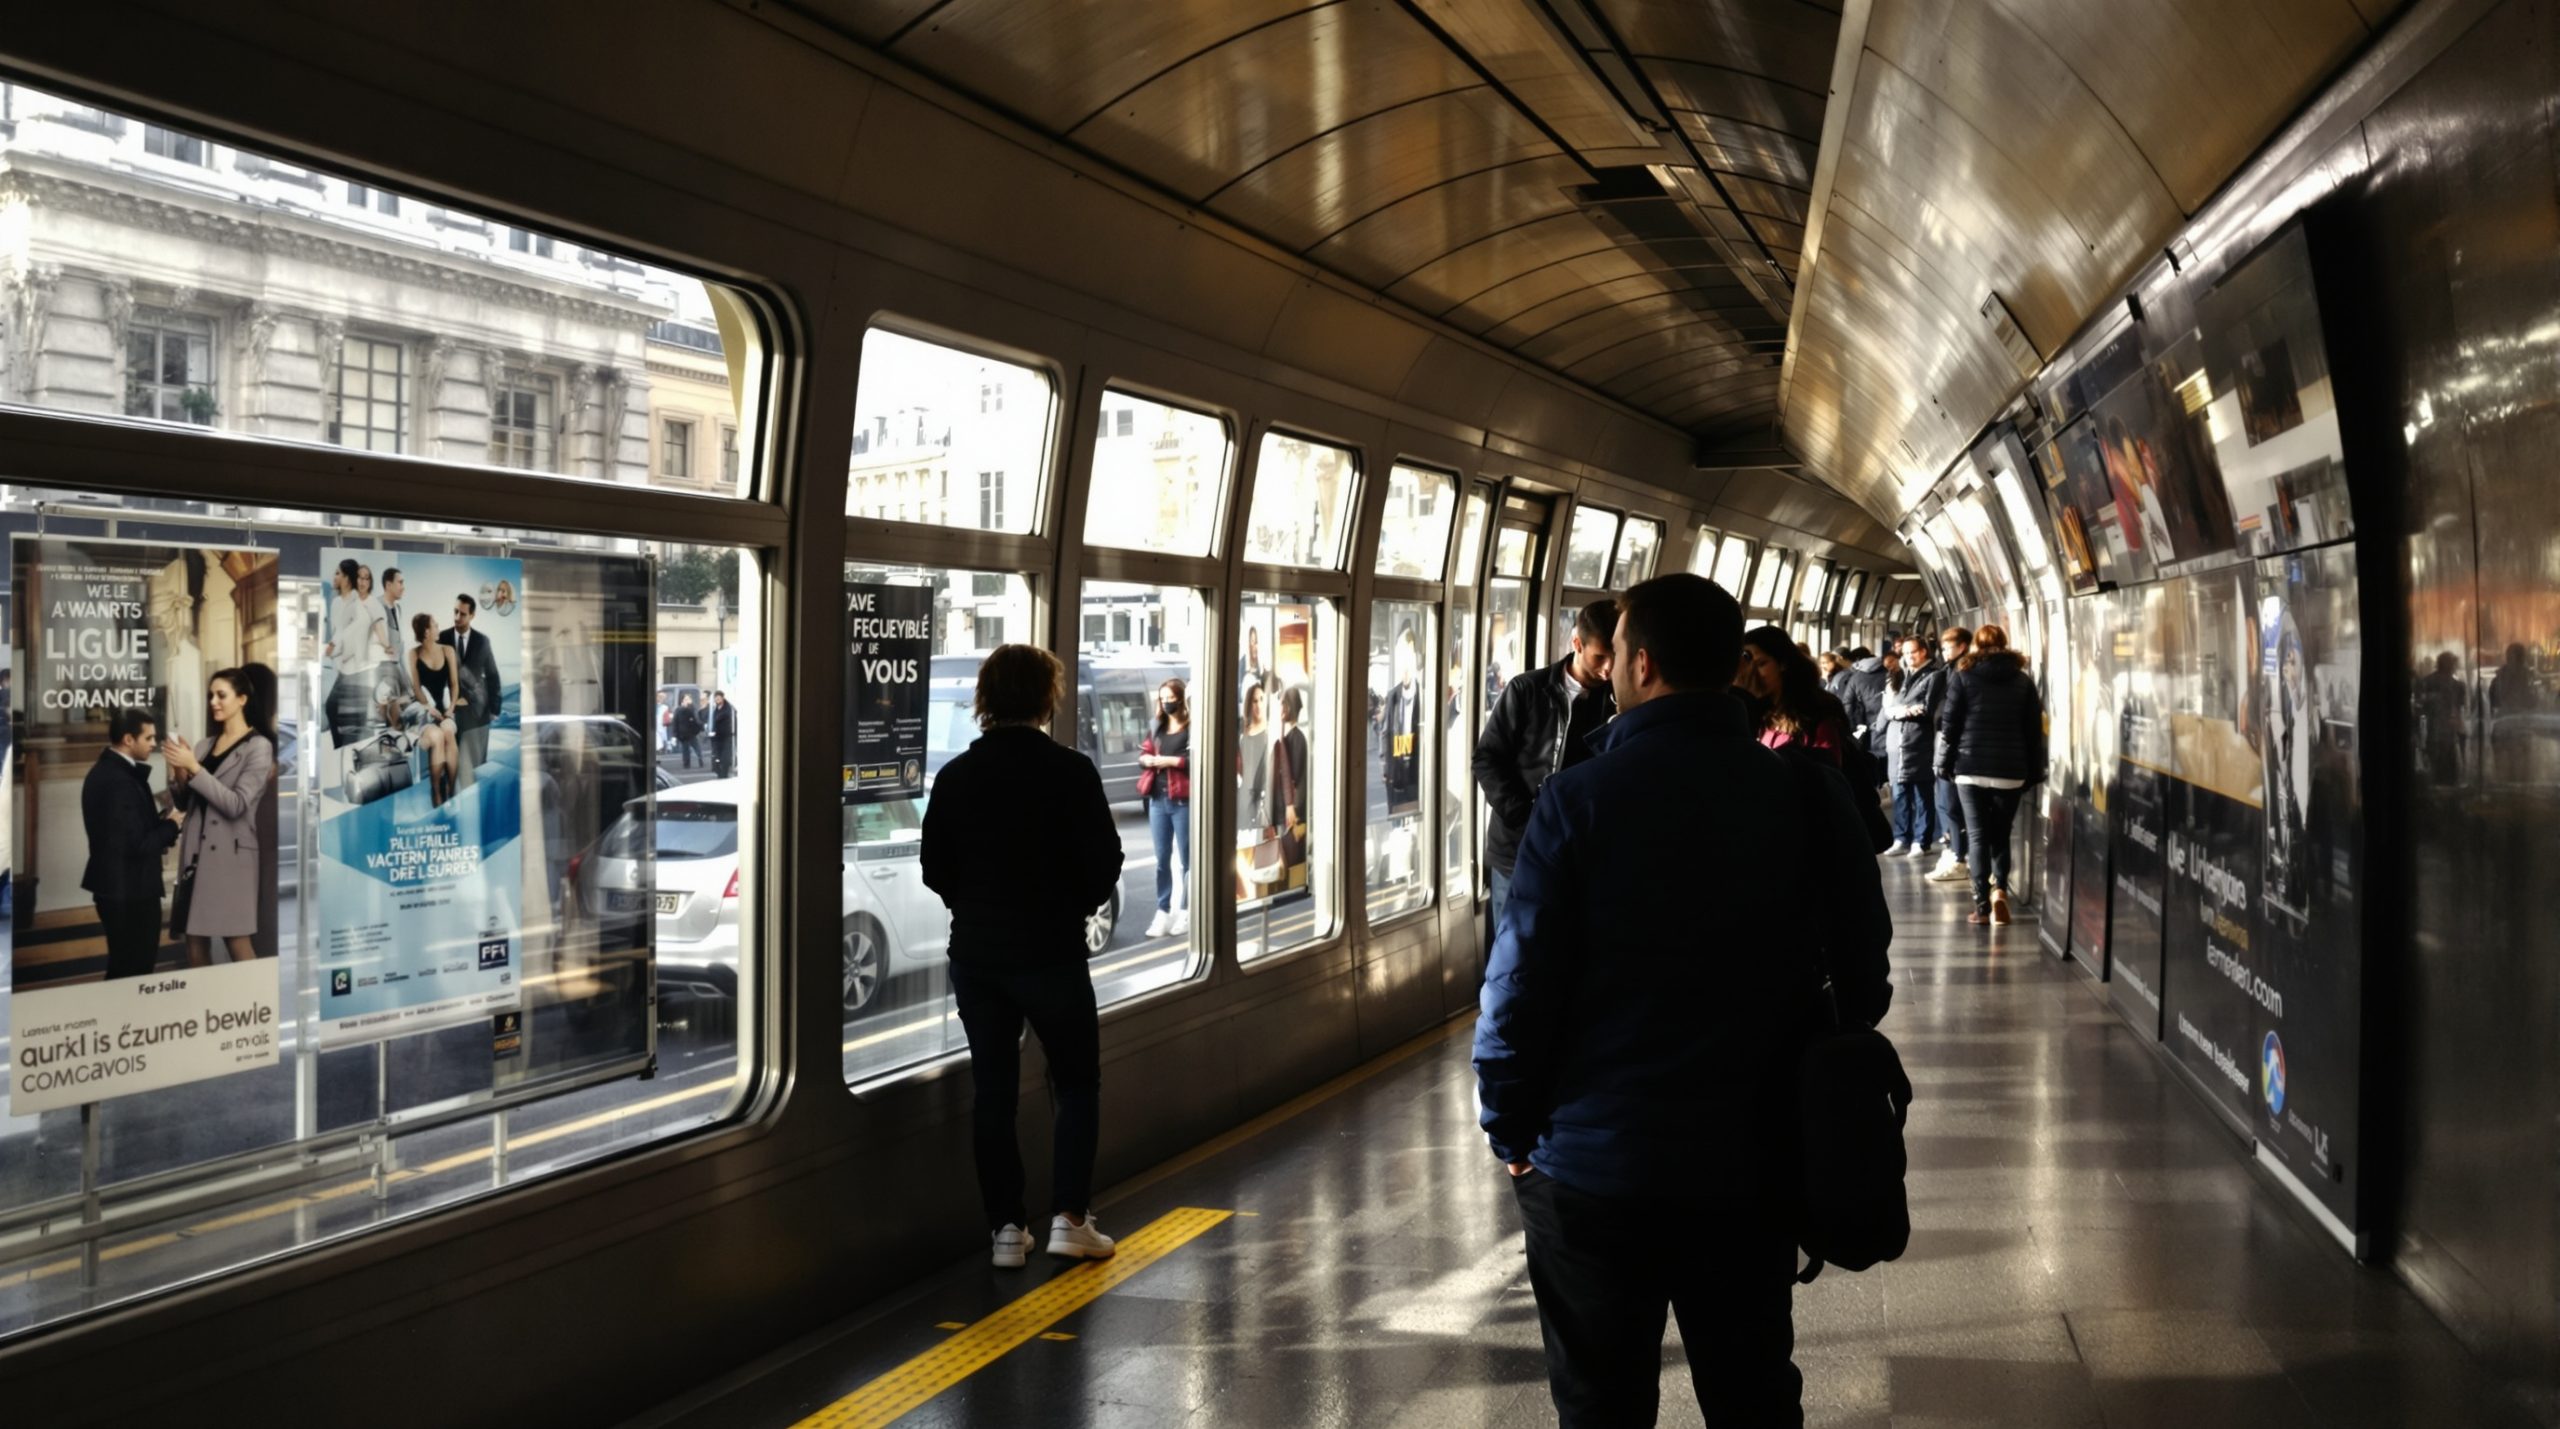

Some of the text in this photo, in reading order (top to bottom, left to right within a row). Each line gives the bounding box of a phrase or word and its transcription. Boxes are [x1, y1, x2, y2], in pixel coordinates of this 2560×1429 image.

[46, 628, 149, 659] LIGUE
[56, 664, 74, 681] IN
[861, 659, 918, 684] VOUS
